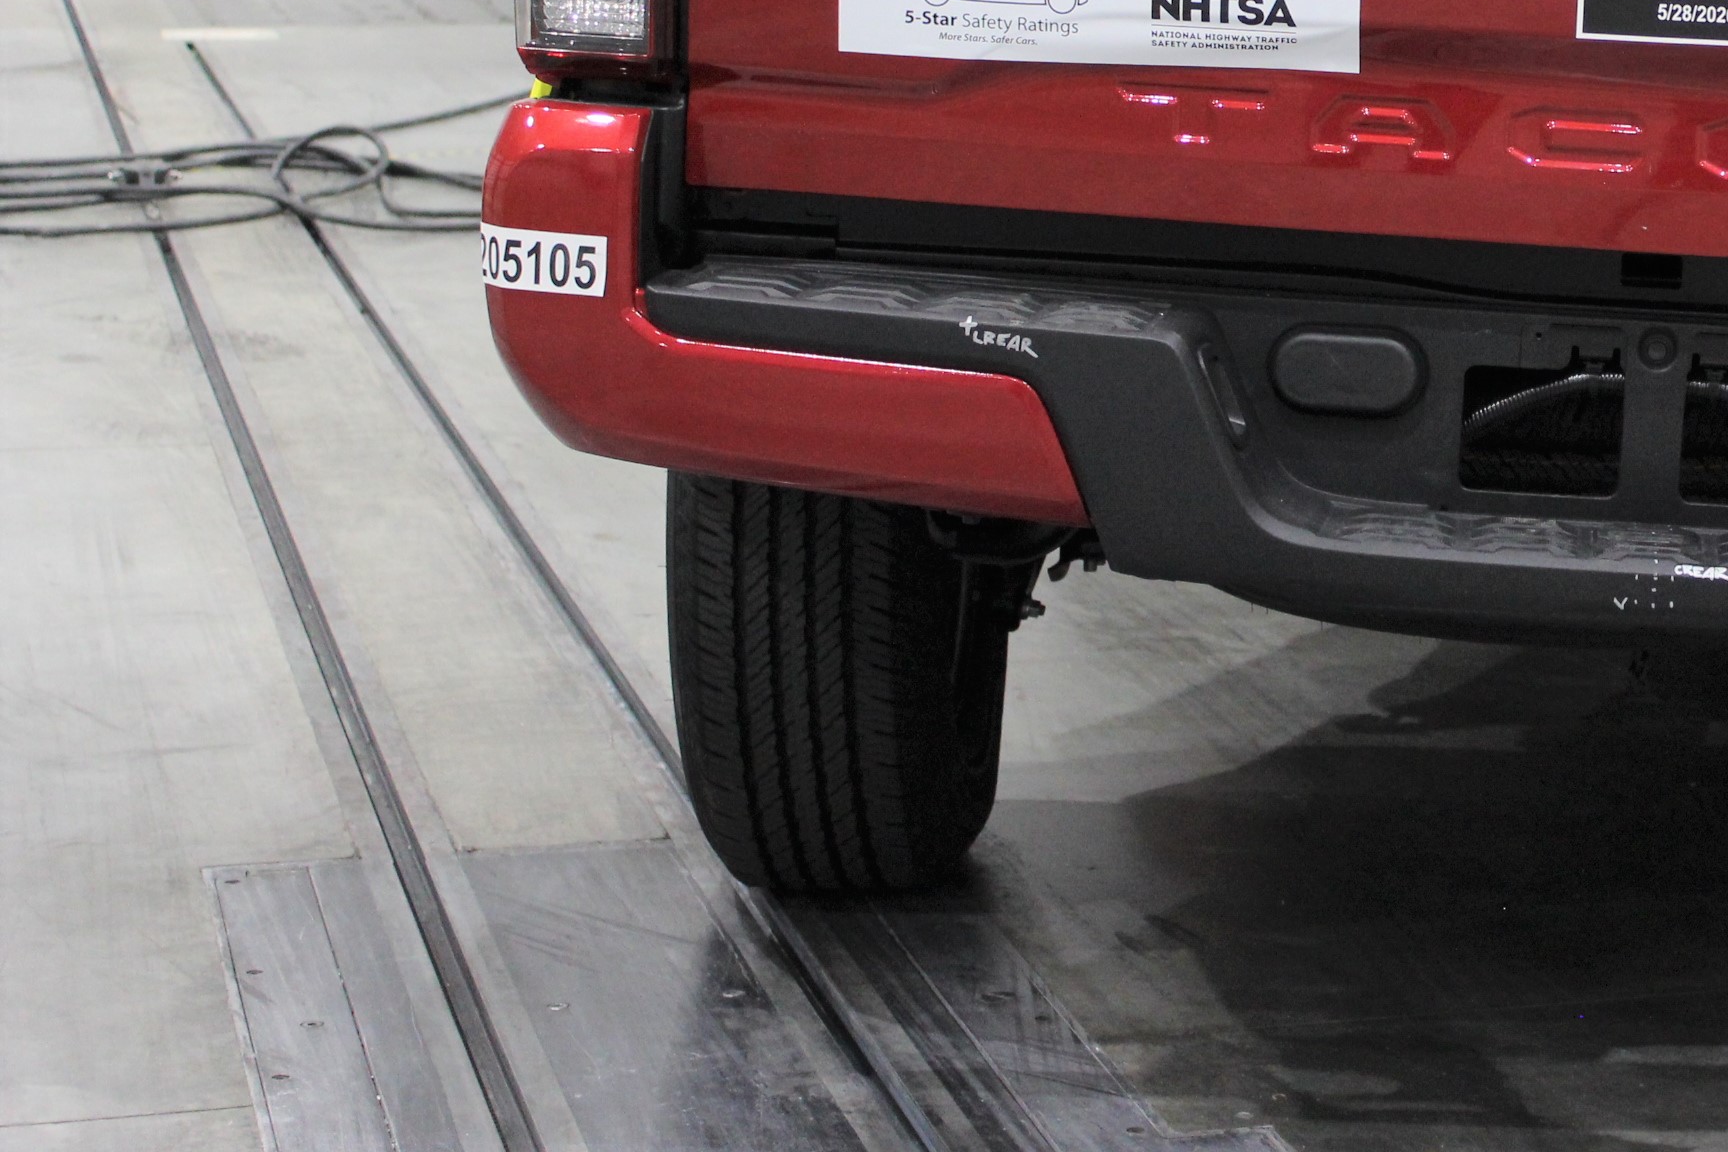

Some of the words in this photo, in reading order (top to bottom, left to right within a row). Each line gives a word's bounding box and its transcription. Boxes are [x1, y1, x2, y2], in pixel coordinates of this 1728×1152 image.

[905, 10, 957, 26] 5-Star
[962, 13, 1013, 34] Safety
[1017, 16, 1079, 37] Ratings
[938, 31, 962, 41] More
[963, 33, 988, 43] Stars.
[990, 35, 1014, 44] Safer
[1015, 36, 1038, 46] Cars.
[1151, 30, 1202, 40] NATIONAL
[1205, 33, 1252, 43] HIGHWAY
[1256, 36, 1297, 44] TRAFFIC
[1151, 39, 1188, 48] SAFETY
[1191, 42, 1279, 51] ADMINISTRATION
[972, 330, 1039, 359] LREAR
